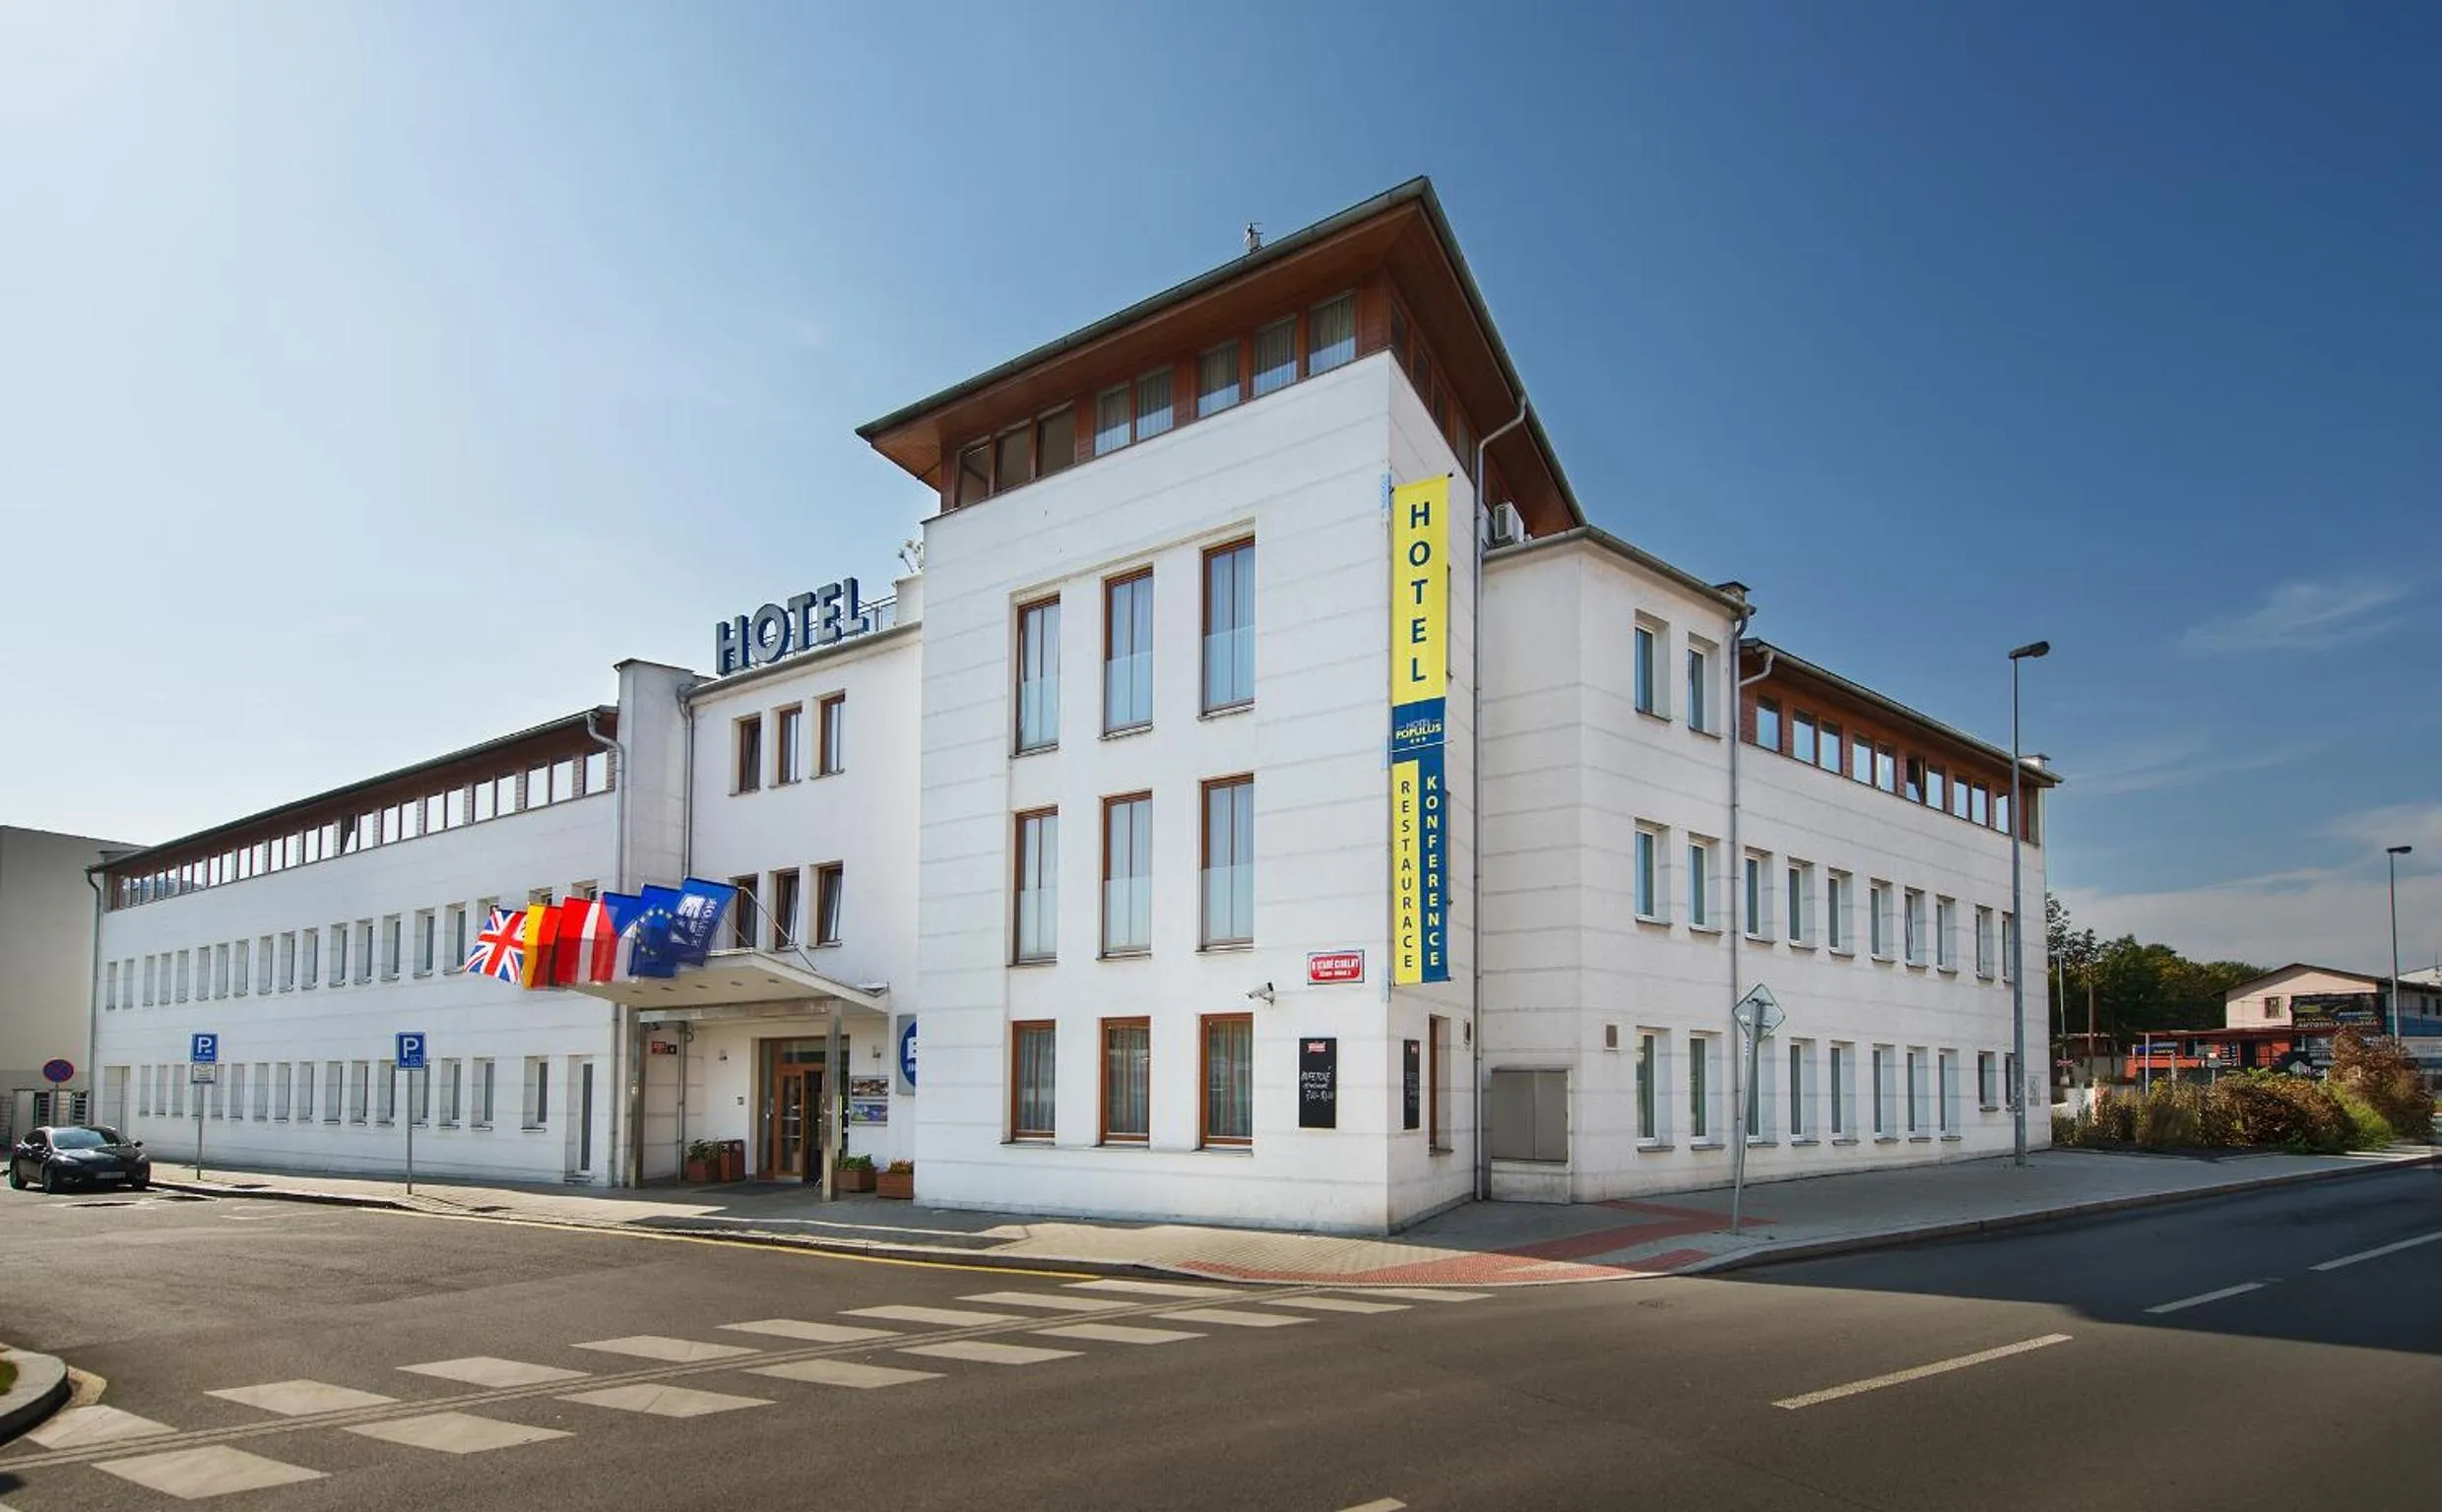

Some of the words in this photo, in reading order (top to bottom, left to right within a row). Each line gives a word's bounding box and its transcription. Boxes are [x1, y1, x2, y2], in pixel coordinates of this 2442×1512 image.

[716, 577, 868, 676] HOTEL
[1409, 501, 1431, 683] HOTEL
[1395, 724, 1442, 739] POPULUS
[1401, 780, 1412, 969] RESTAURACE
[1426, 776, 1441, 967] KONFERENCE
